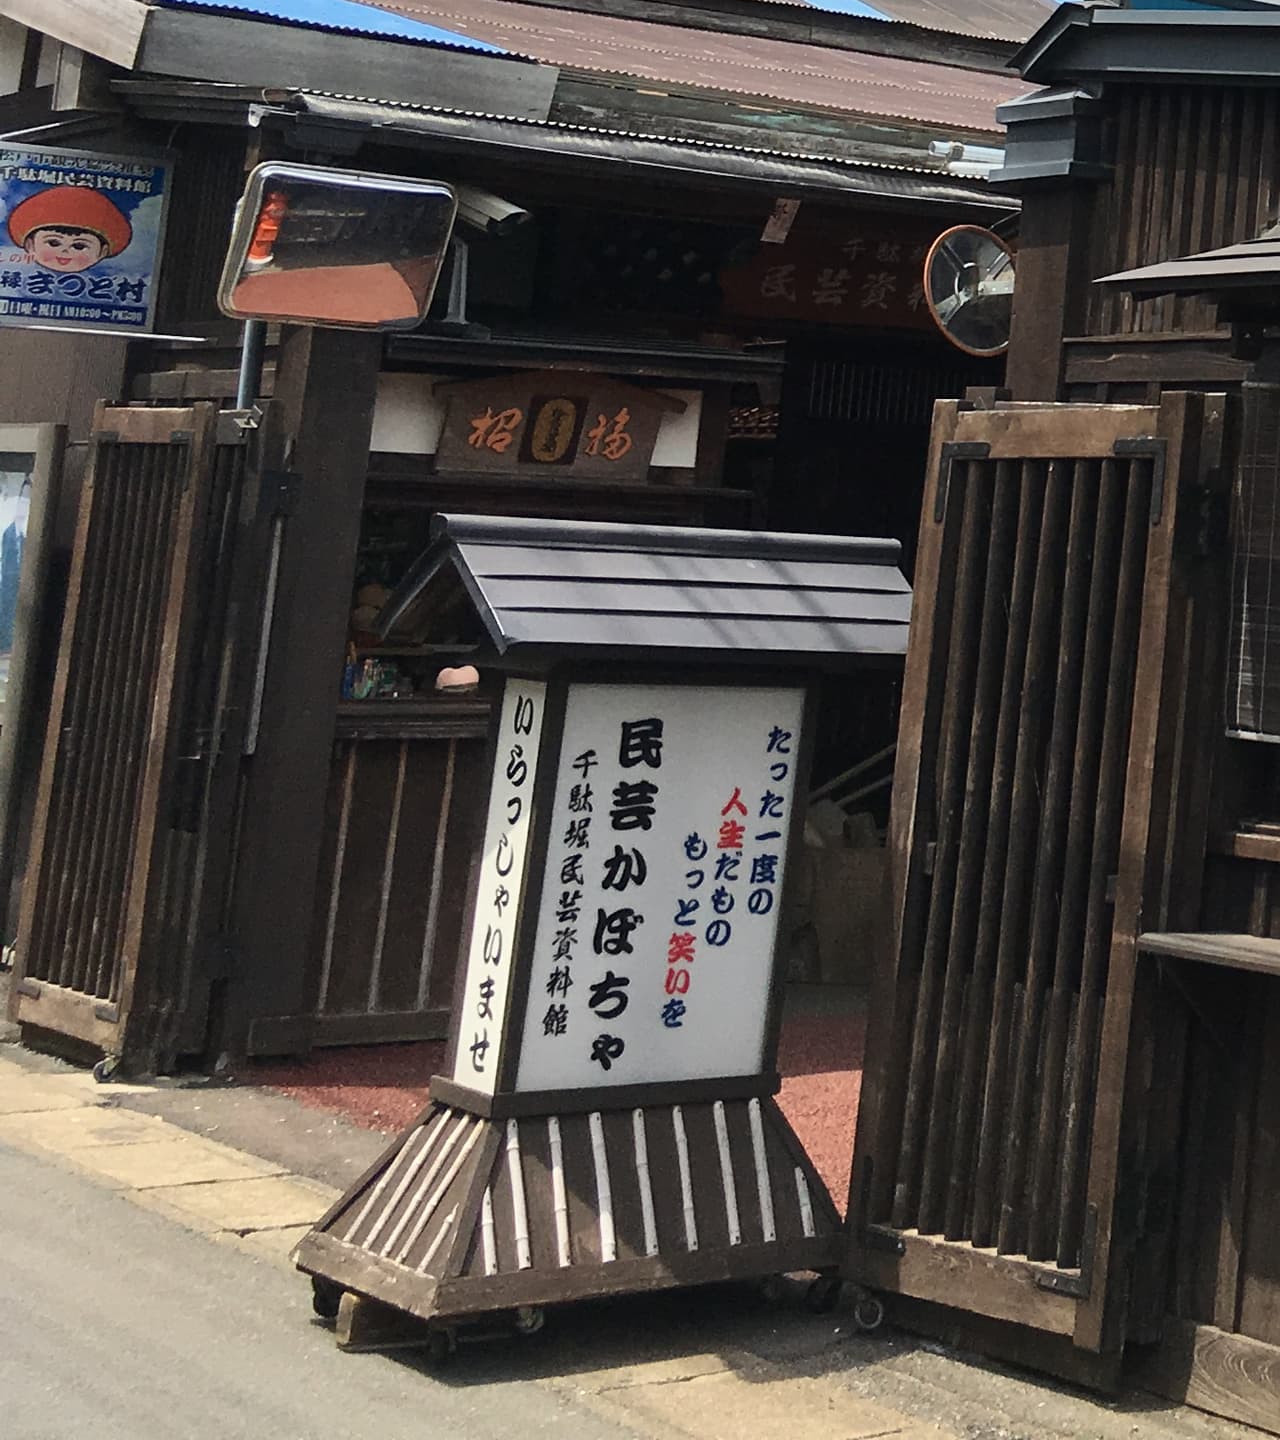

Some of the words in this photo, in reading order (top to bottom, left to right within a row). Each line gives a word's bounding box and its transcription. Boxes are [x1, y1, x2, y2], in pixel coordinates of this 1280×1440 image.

[469, 694, 534, 1073] いらっしゃいませ
[542, 749, 599, 1037] 千駄堀民芸資料館
[588, 718, 664, 1071] 民芸かぼちゃ
[661, 831, 709, 1029] もっと笑いを
[706, 787, 748, 947] 人生だもの
[747, 725, 792, 916] たった一度の
